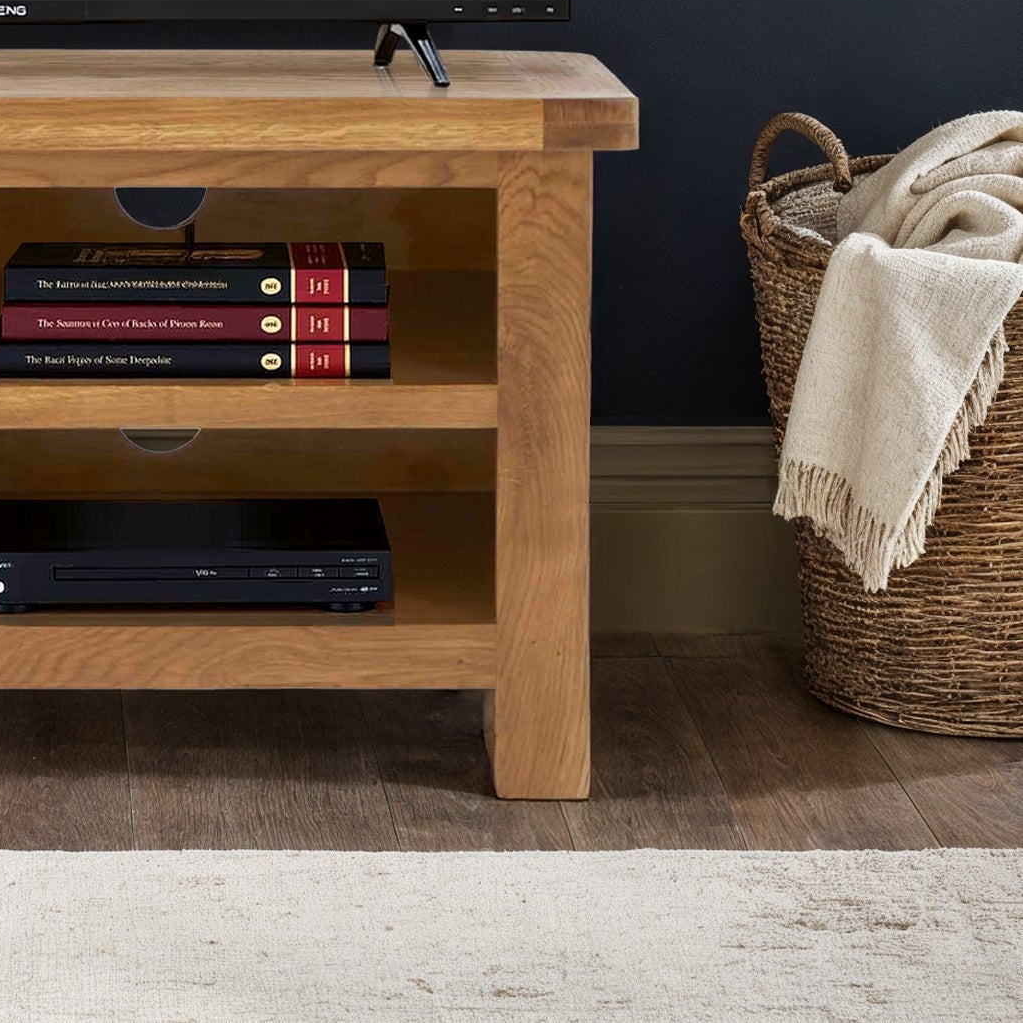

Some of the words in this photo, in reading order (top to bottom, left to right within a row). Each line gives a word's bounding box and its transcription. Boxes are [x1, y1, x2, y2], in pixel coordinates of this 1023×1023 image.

[37, 280, 54, 289] The
[37, 319, 55, 328] The
[25, 355, 43, 365] The
